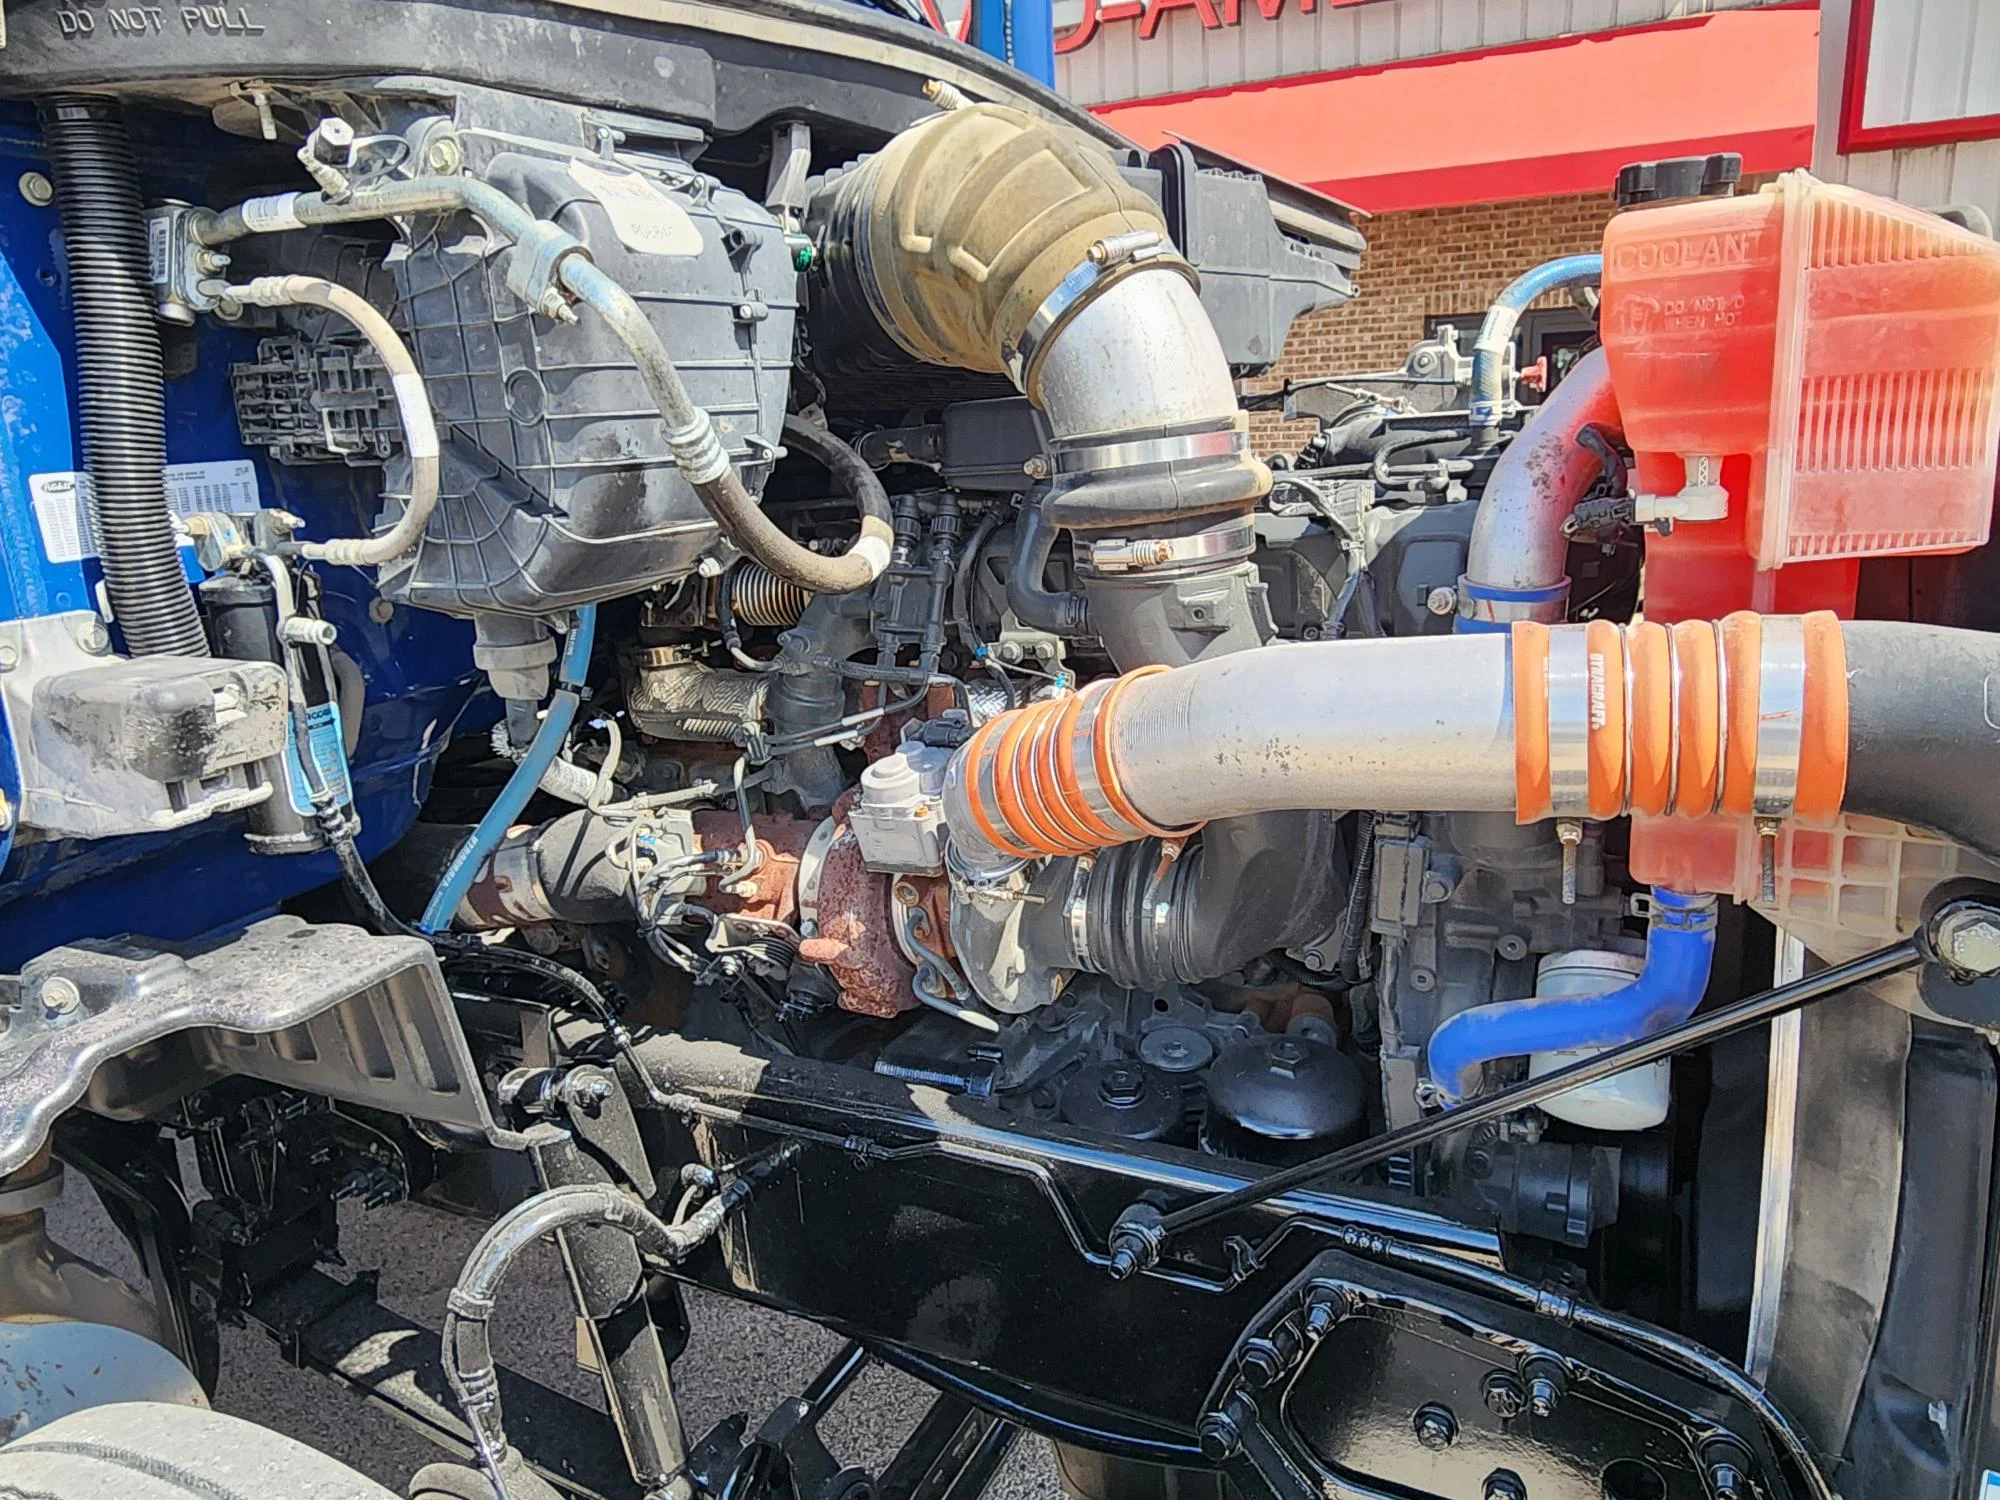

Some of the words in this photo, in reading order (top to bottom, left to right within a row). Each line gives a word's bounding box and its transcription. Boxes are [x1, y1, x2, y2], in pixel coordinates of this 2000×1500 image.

[57, 9, 95, 33] DO
[108, 7, 162, 31] NOT
[180, 6, 266, 30] PULL
[1617, 231, 1762, 269] COOLANT
[1664, 300, 1685, 315] DO
[1694, 295, 1725, 312] NOT
[1589, 653, 1606, 726] DYNACRAFT
